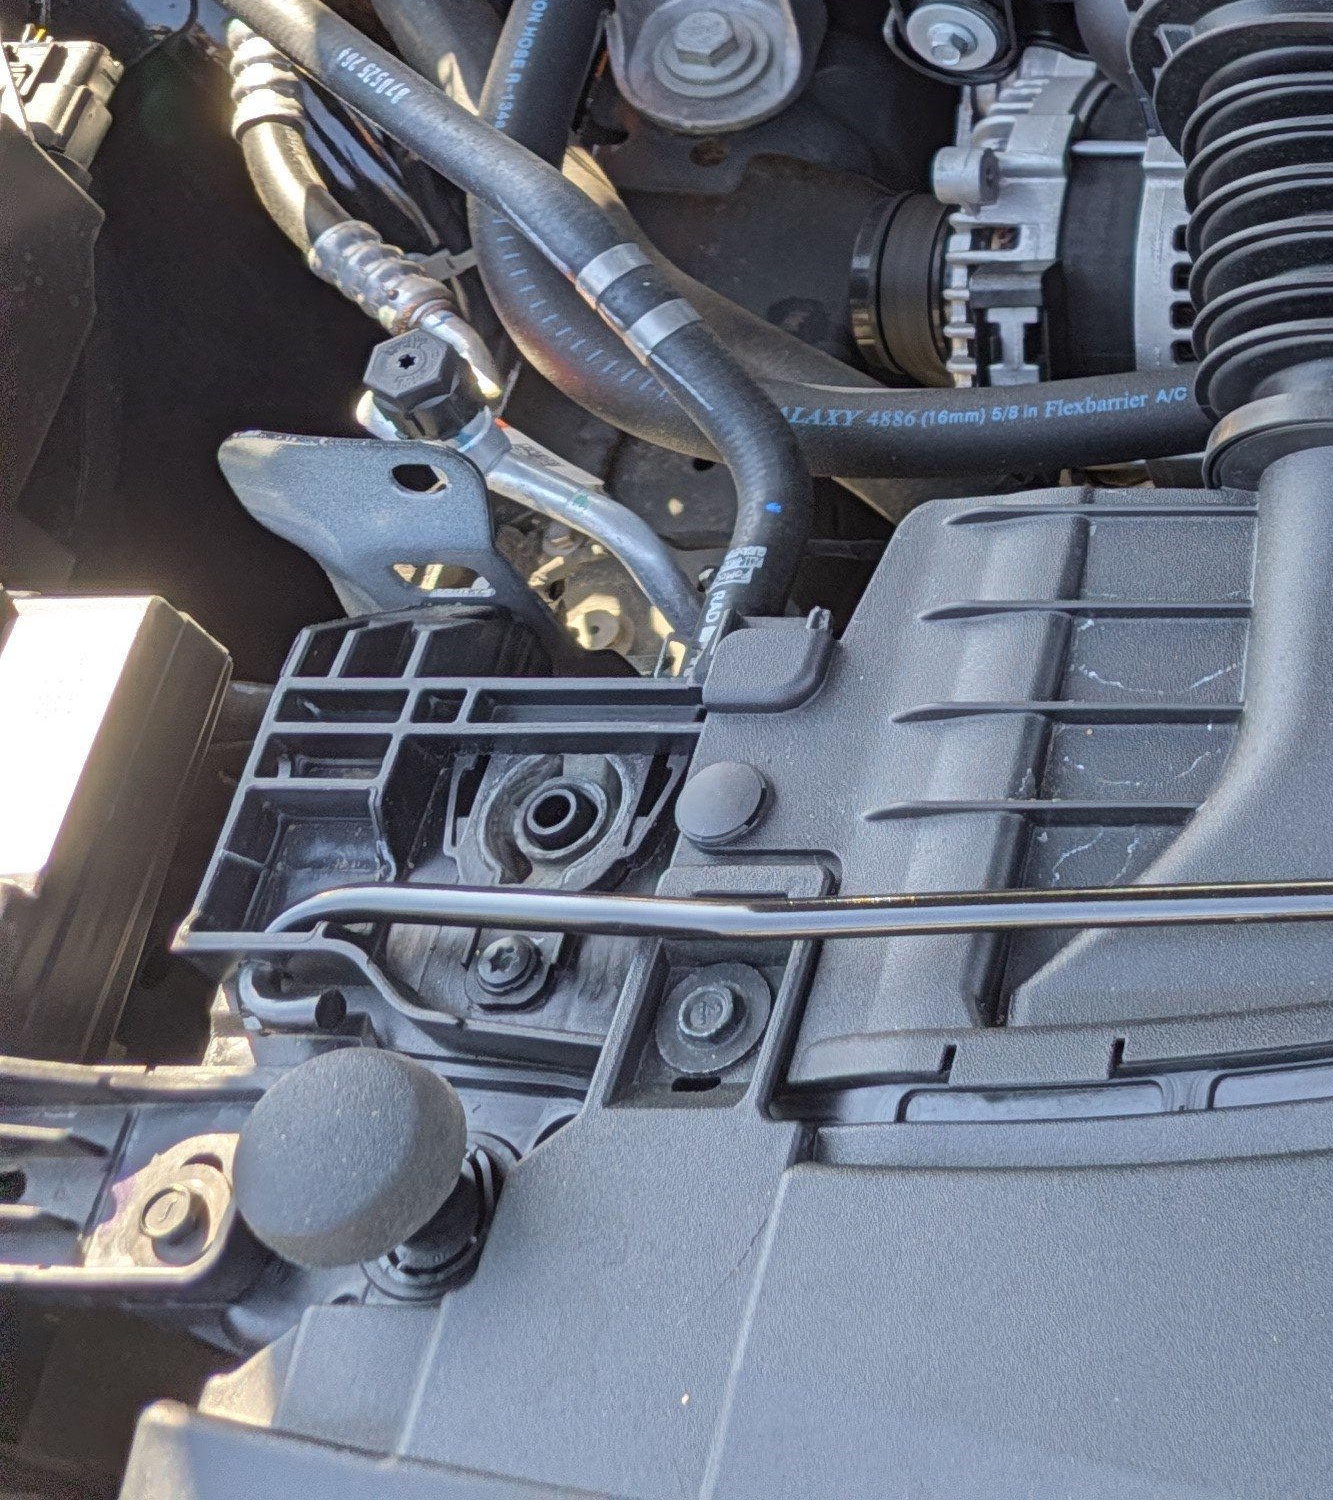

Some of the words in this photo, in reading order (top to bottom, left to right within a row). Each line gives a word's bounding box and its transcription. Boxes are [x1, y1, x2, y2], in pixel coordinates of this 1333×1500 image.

[866, 409, 917, 427] 4886
[920, 407, 986, 428] (16mm)
[990, 404, 1020, 422] 5/8
[1044, 392, 1148, 418] Flexbarrier
[1155, 386, 1188, 404] A/C
[706, 590, 726, 623] RAD
